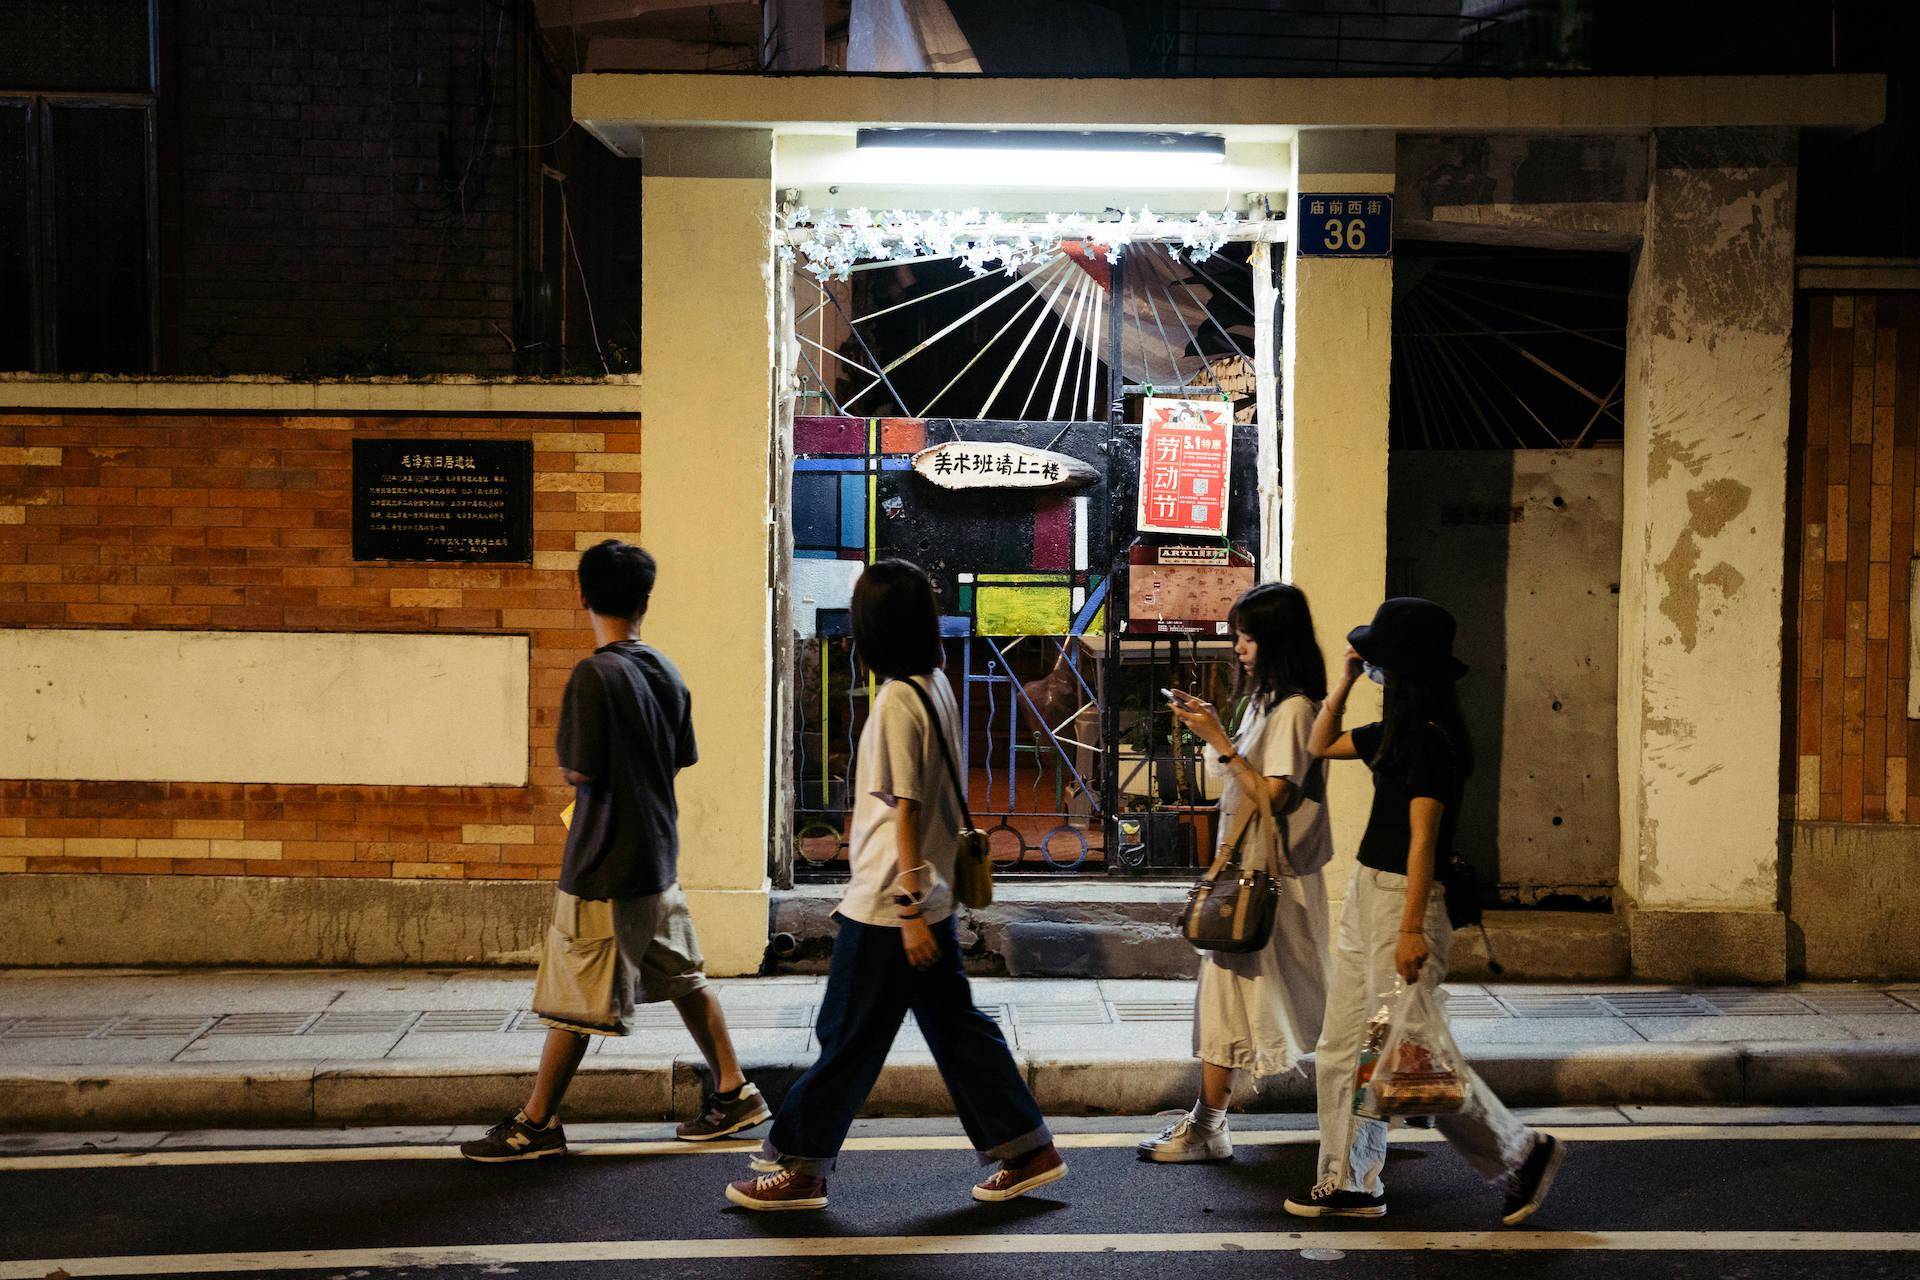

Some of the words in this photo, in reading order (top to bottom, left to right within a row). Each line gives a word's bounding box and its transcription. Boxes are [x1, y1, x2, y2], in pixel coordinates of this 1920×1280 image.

[1310, 200, 1383, 215] 庙前西街
[1323, 218, 1366, 251] 36
[401, 454, 476, 470] 毛泽东旧居遗址
[934, 452, 1060, 481] 美术班请上二楼
[1152, 436, 1181, 518] 劳动节
